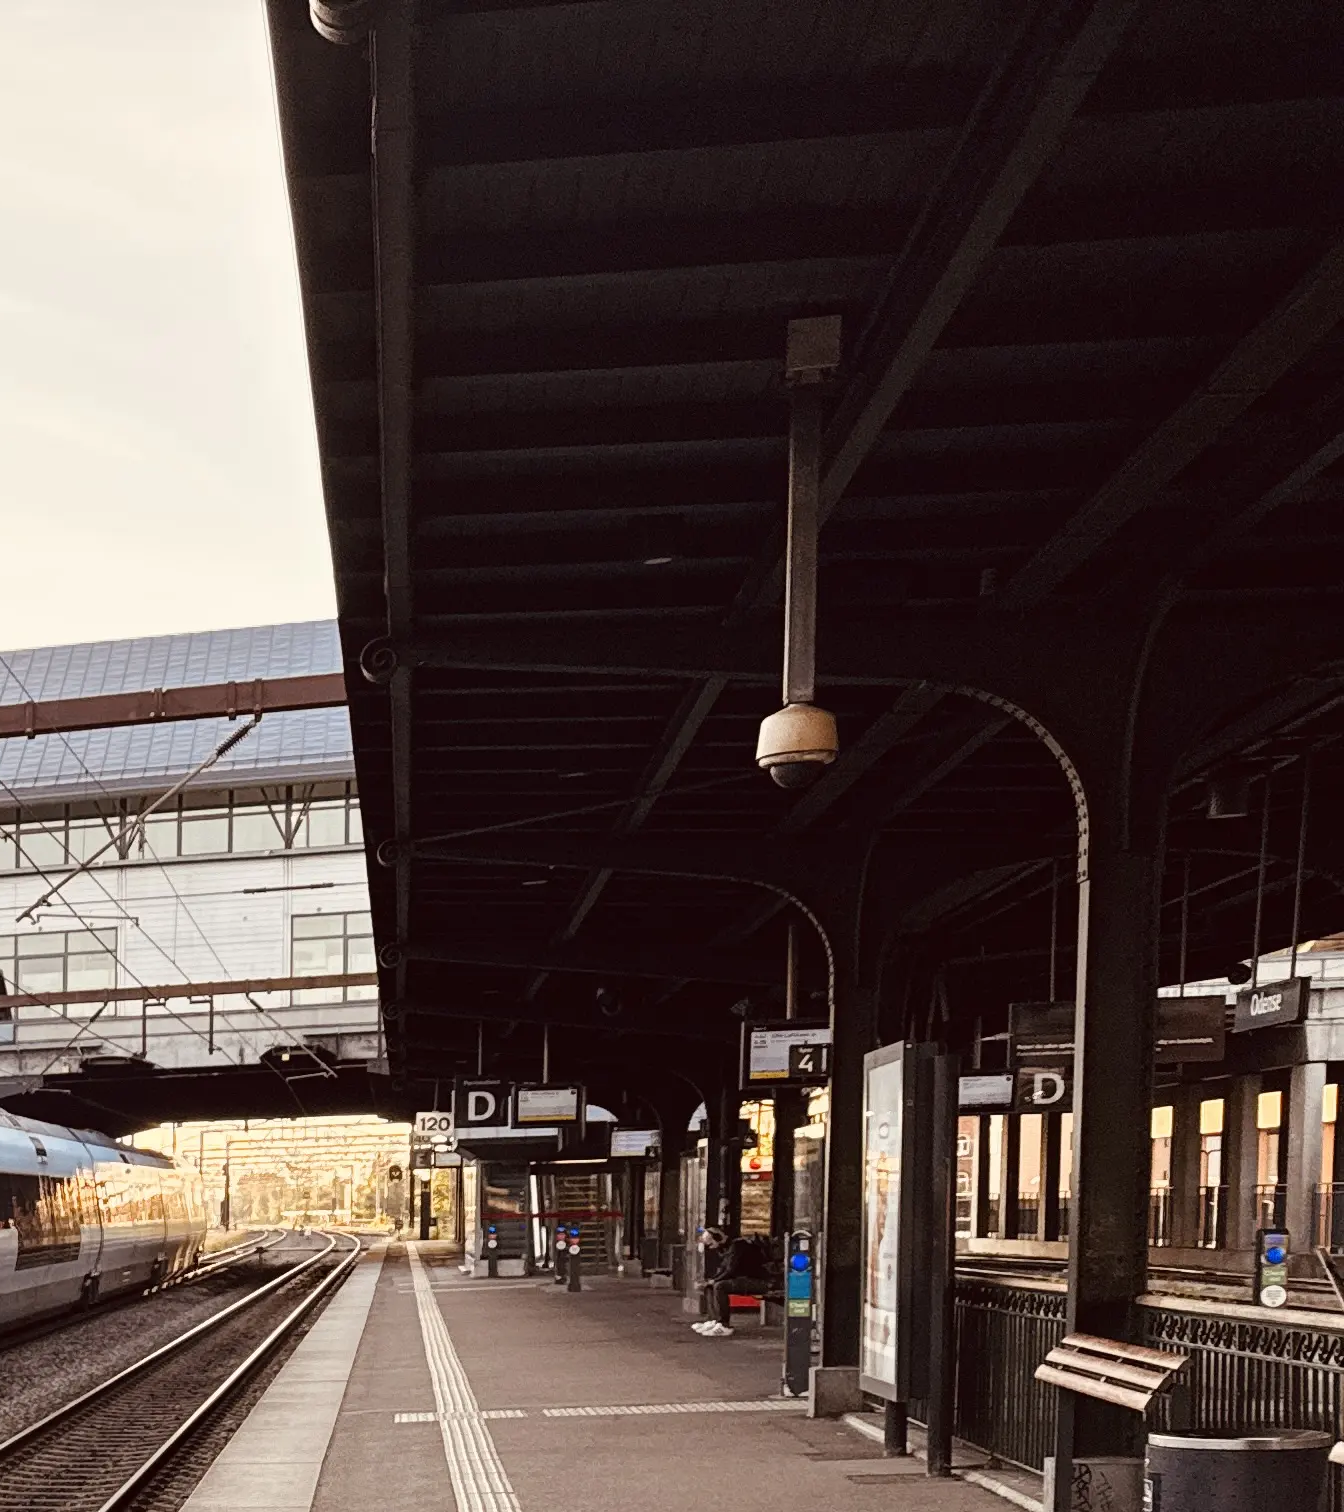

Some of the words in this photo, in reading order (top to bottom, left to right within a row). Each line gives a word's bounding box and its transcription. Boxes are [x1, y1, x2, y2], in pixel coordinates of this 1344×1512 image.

[1250, 991, 1282, 1016] Odense
[798, 1054, 813, 1072] 4
[1033, 1072, 1065, 1105] D
[467, 1091, 496, 1121] D
[420, 1116, 451, 1131] 120
